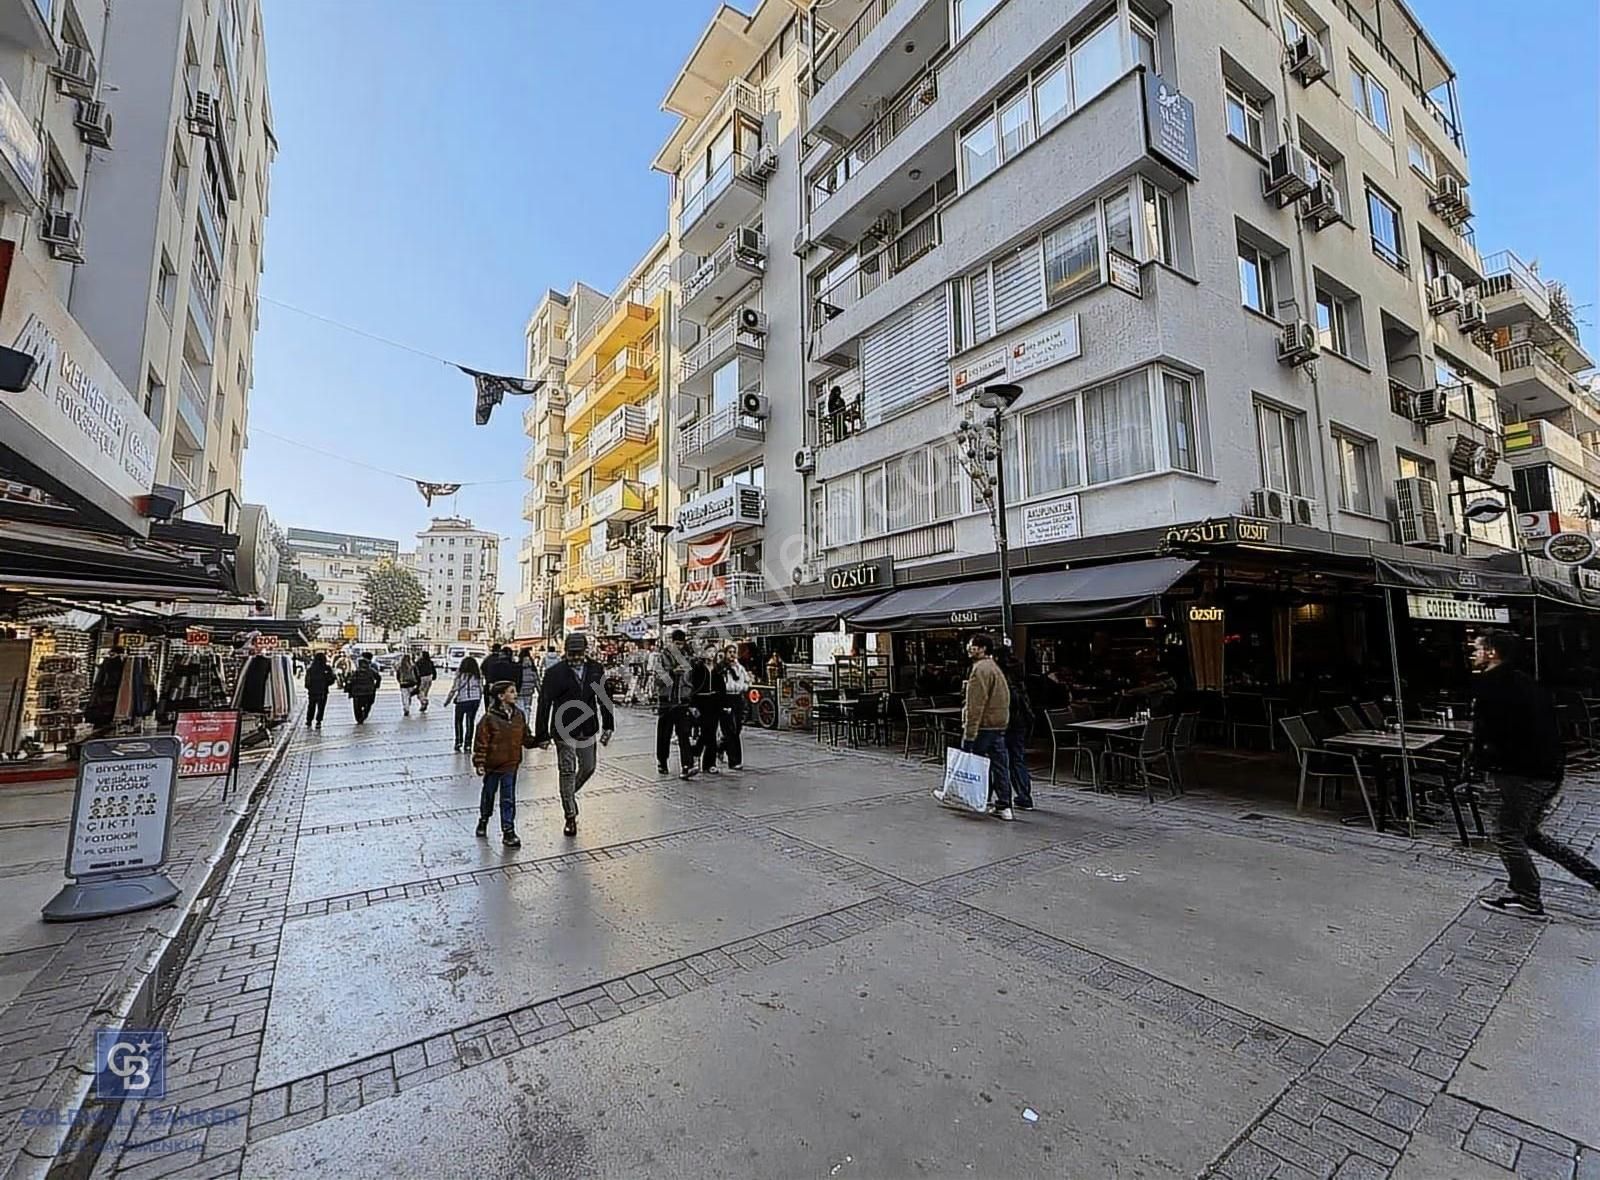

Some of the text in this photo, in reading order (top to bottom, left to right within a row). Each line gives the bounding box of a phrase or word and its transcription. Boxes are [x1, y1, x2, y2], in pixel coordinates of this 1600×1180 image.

[1166, 521, 1228, 543] ÖZSÜT
[1239, 520, 1269, 540] ÖZSÜT
[831, 563, 877, 589] ÖZSÜT
[951, 611, 978, 623] ÖZSÜT
[1189, 606, 1224, 621] ÖZSÜT
